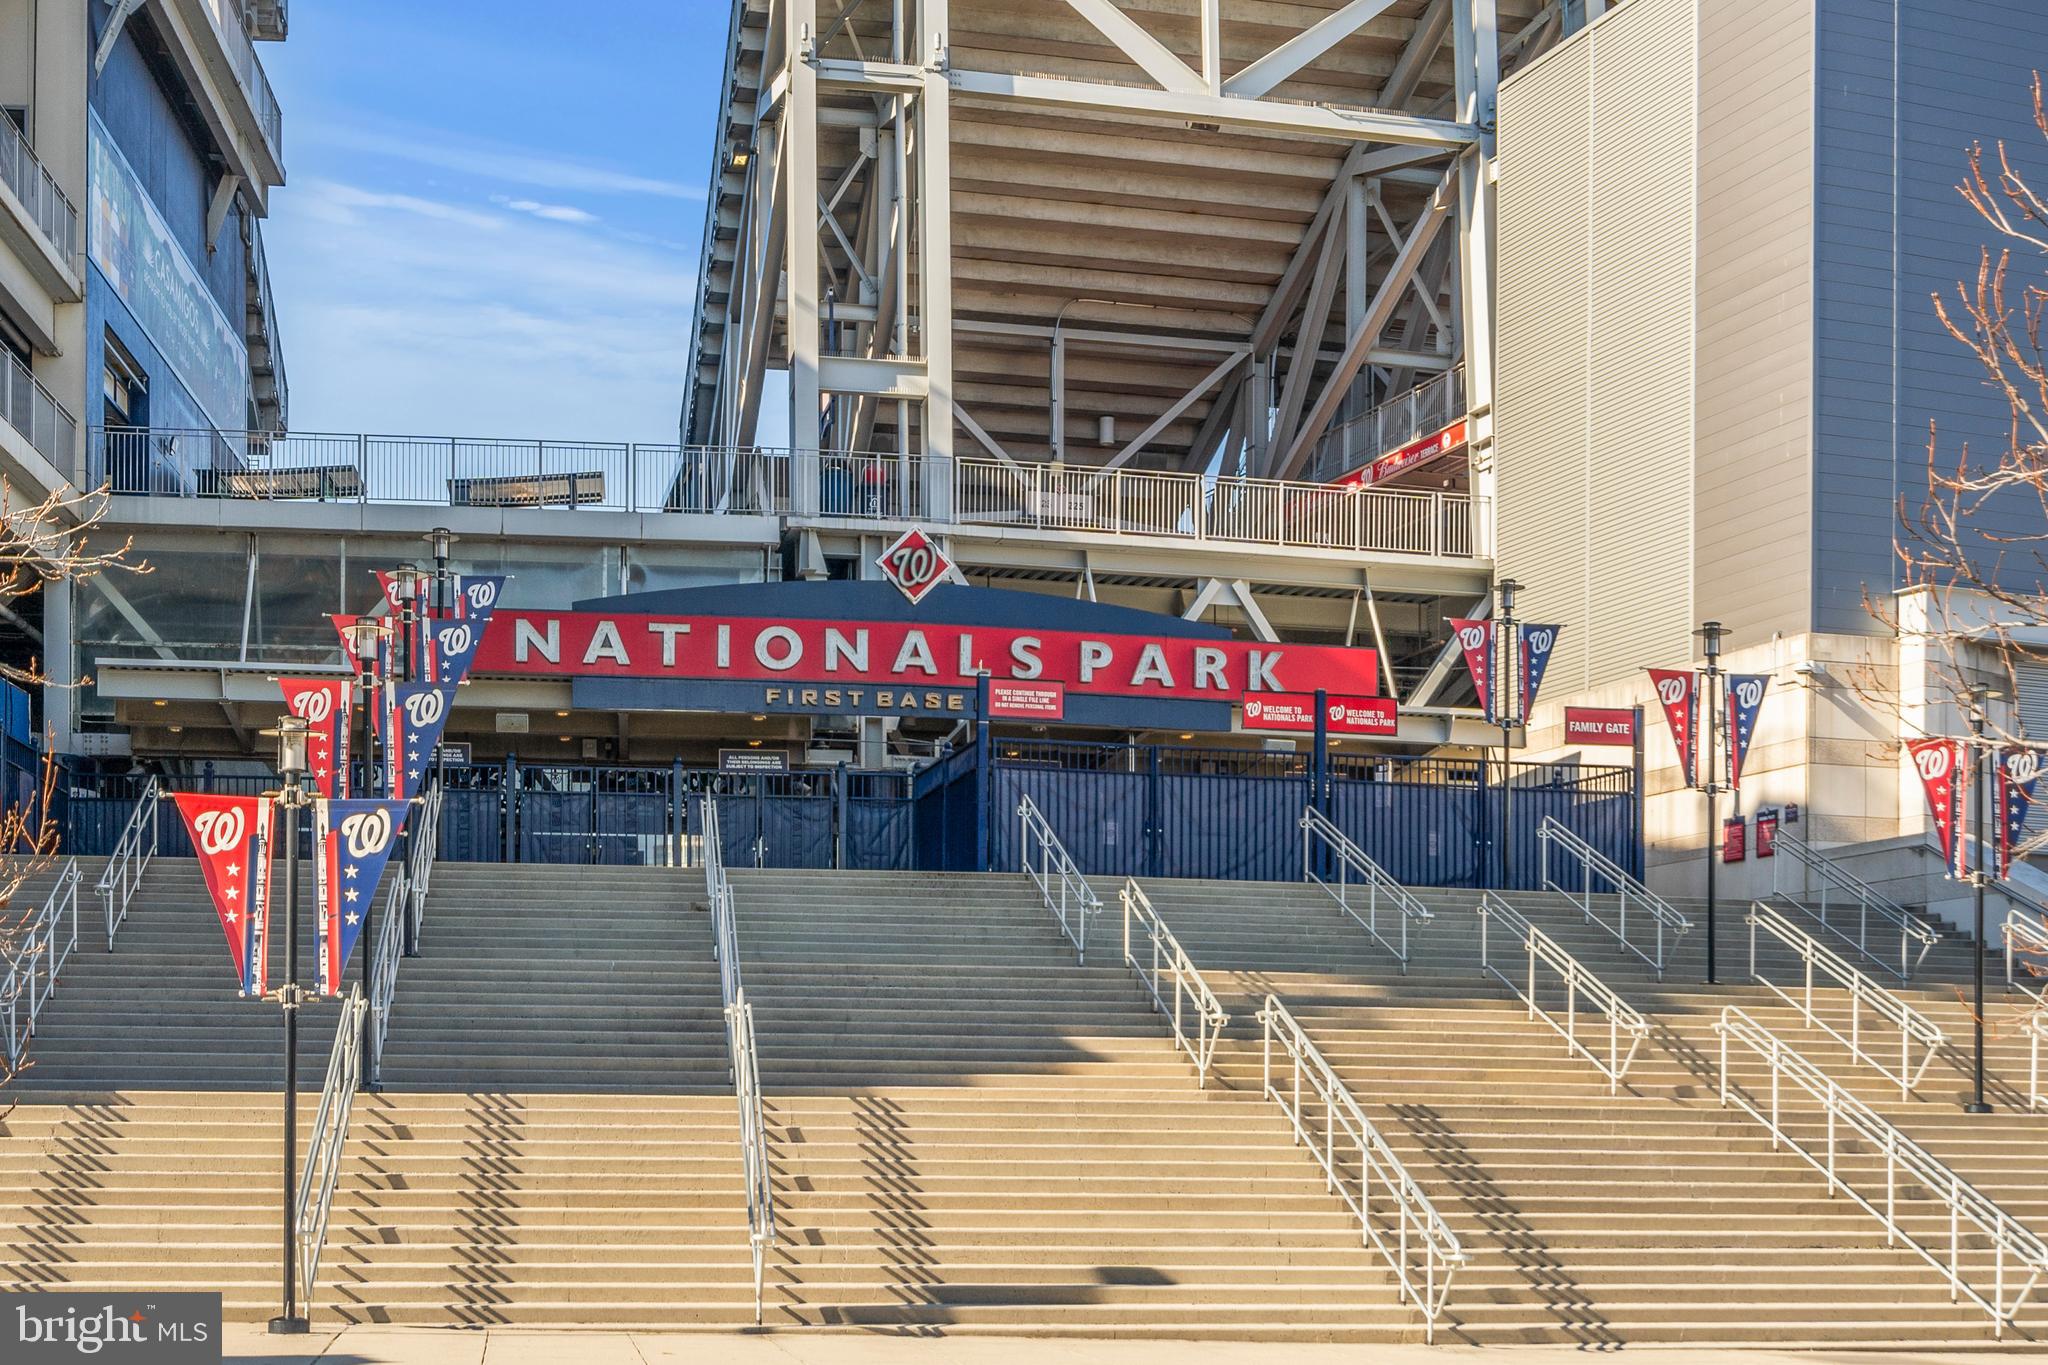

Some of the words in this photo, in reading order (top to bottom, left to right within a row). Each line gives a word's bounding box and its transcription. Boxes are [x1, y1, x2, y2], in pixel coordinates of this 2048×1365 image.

[155, 249, 199, 334] CASAMIGOS
[515, 618, 1042, 679] NATIONALS
[1080, 641, 1284, 691] PARK
[766, 688, 864, 706] FIRST
[876, 691, 964, 710] BASE
[1262, 705, 1292, 714] WELCOME
[1293, 706, 1302, 714] TO
[1346, 709, 1376, 718] WELCOME
[1376, 710, 1385, 718] TO
[1263, 713, 1296, 722] NATIONALS
[1296, 714, 1313, 722] PARK
[1346, 717, 1378, 726] NATIONALS
[1379, 719, 1396, 727] PARK
[1569, 721, 1604, 733] FAMILY
[1606, 722, 1630, 734] GATE
